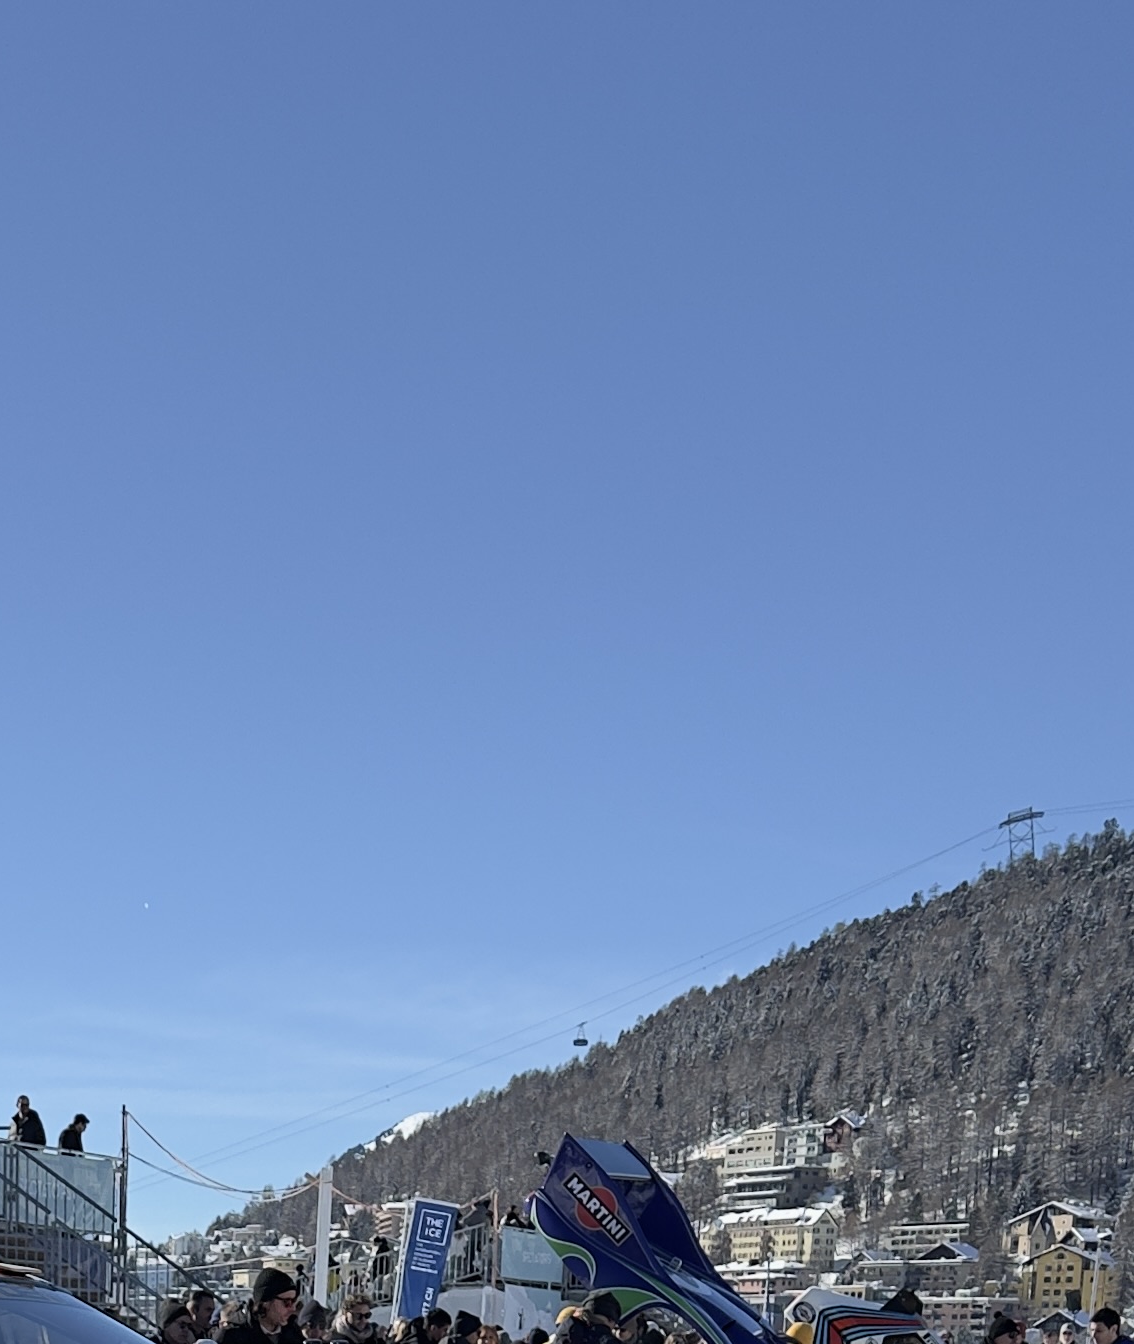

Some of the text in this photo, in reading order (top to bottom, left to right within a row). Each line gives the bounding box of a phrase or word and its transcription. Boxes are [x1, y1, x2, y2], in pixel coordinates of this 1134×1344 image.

[567, 1176, 628, 1241] MARTINI
[426, 1216, 444, 1229] THE
[425, 1228, 442, 1239] ICE
